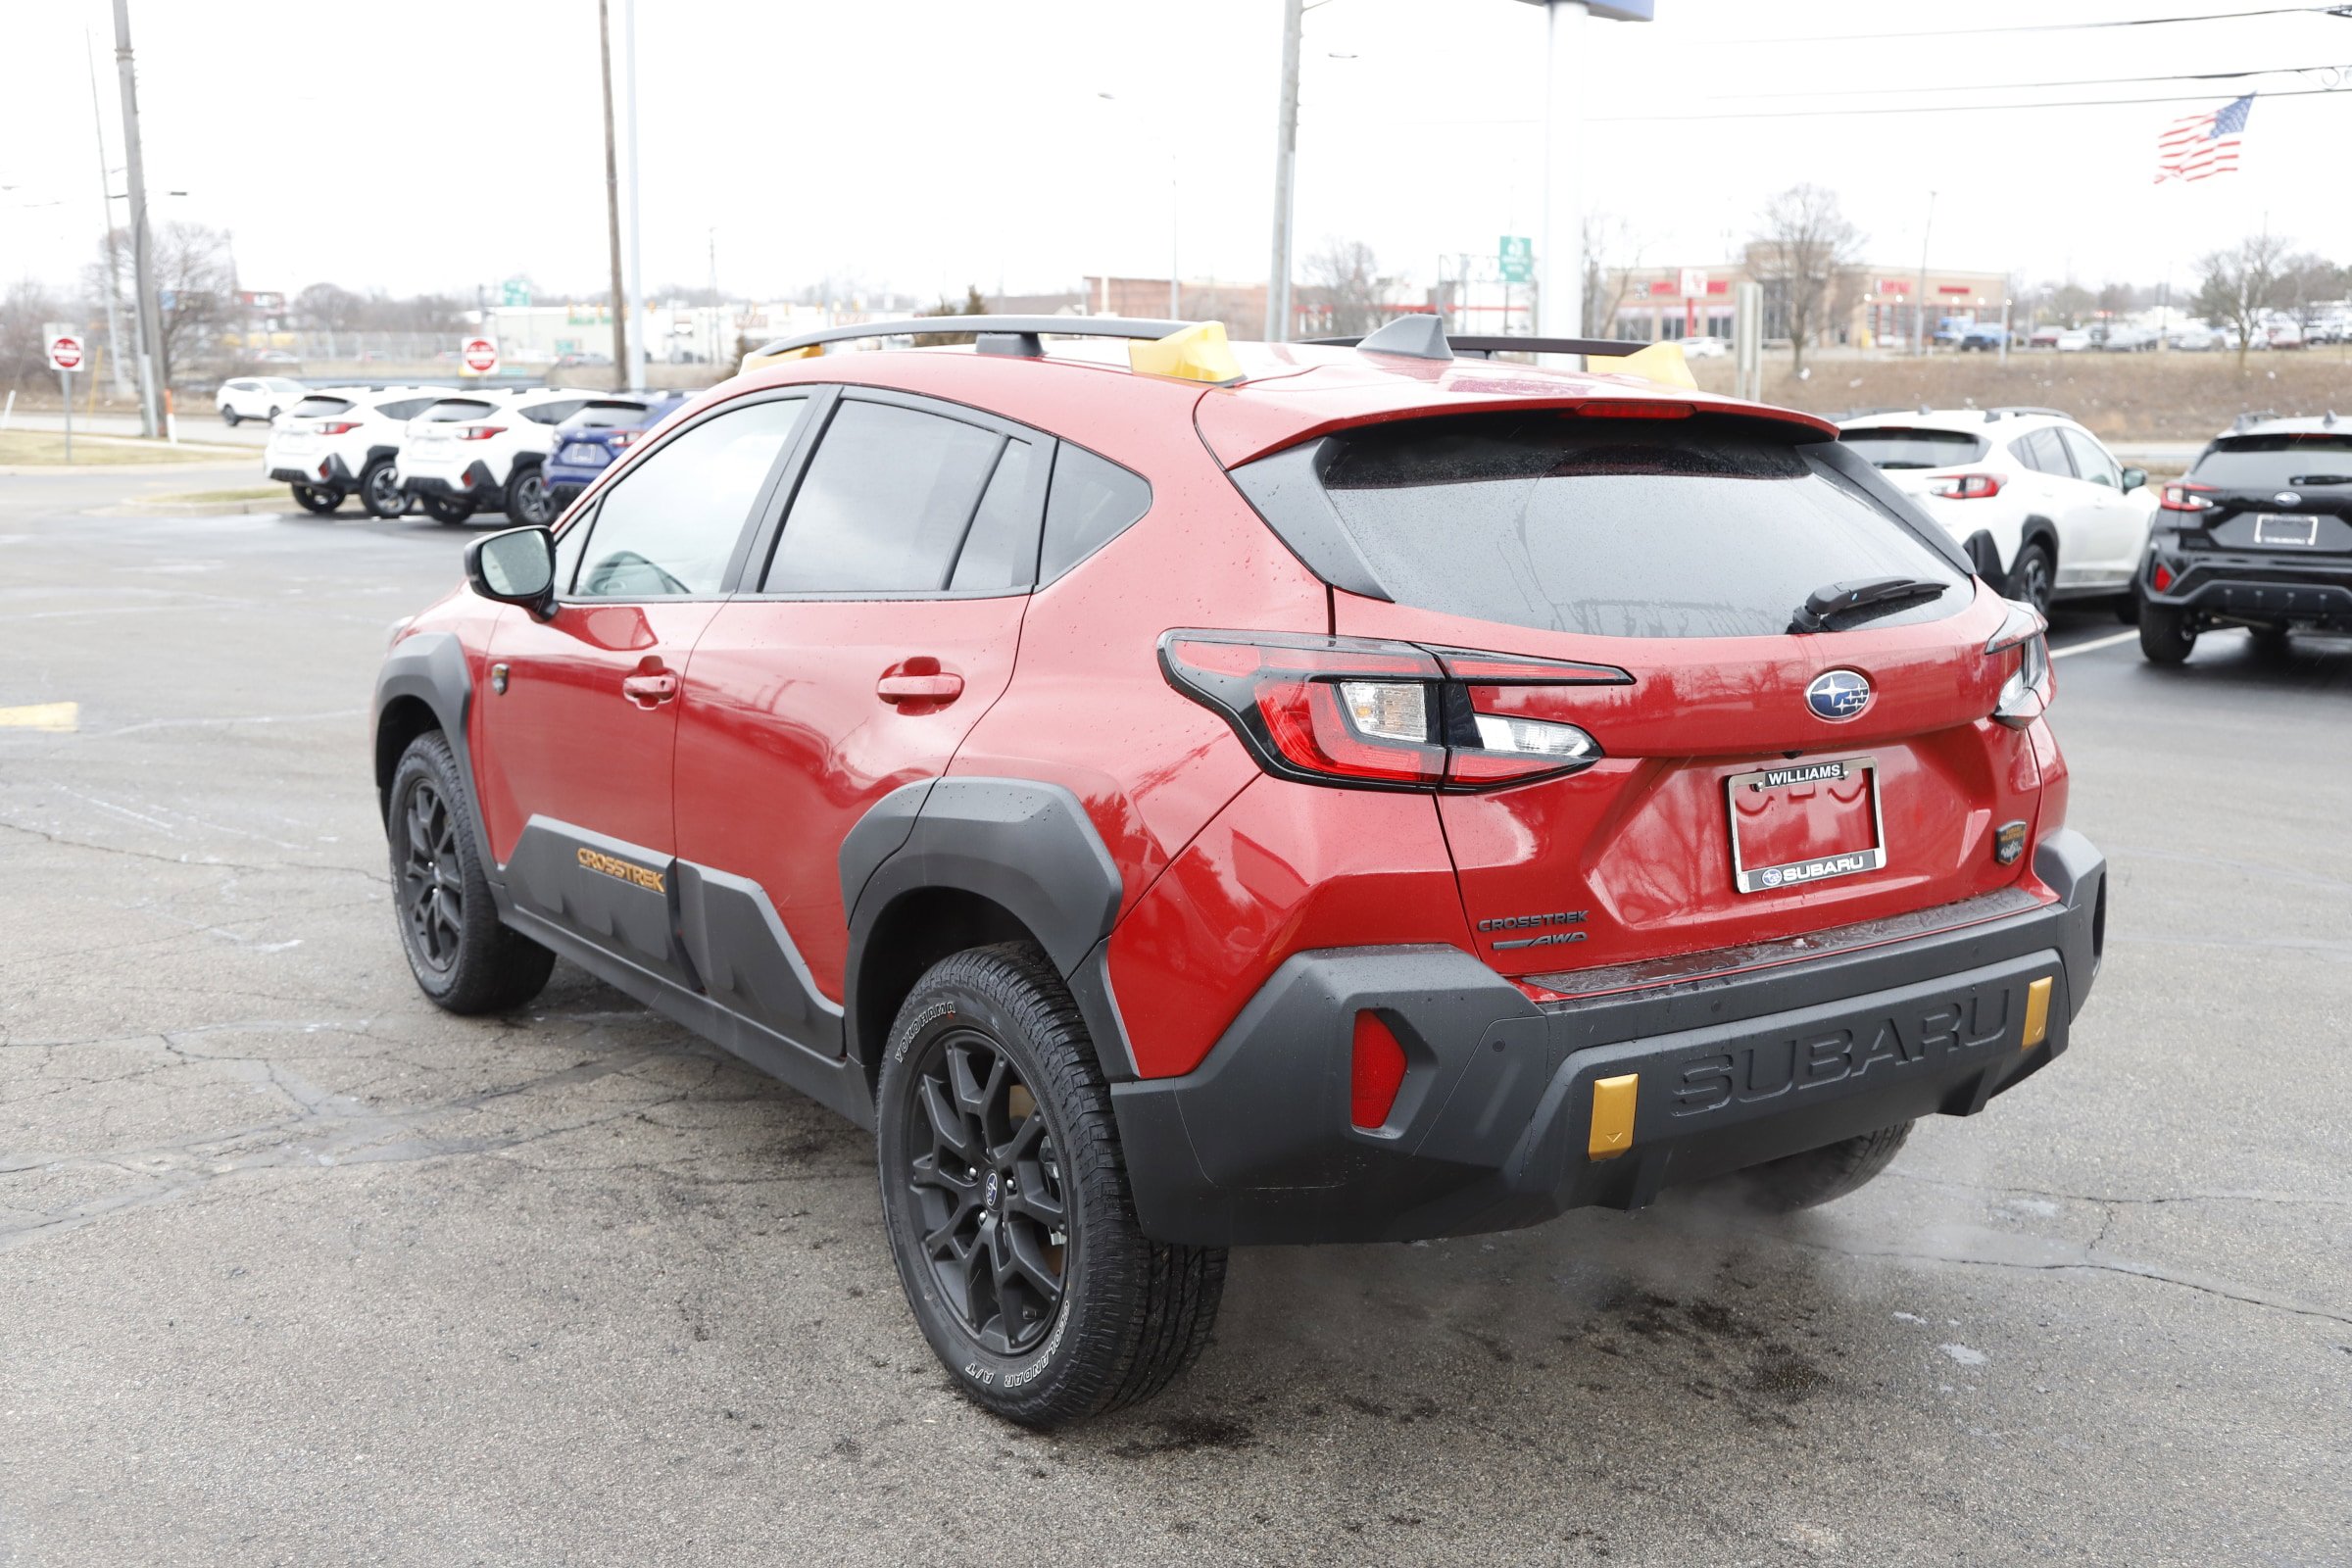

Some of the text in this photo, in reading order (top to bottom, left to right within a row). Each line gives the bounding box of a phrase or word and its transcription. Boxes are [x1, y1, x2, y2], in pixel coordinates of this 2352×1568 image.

[1768, 764, 1840, 785] WILLIAMS
[576, 847, 665, 893] CROSSTREK
[1783, 856, 1864, 882] SUBARU
[1477, 909, 1589, 933] CROSSTREK
[1528, 931, 1588, 948] AWD
[894, 1002, 956, 1063] YOKOHAMA
[1670, 988, 2010, 1117] SUBARU
[964, 1299, 1070, 1388] GEOLANDAR A/T
